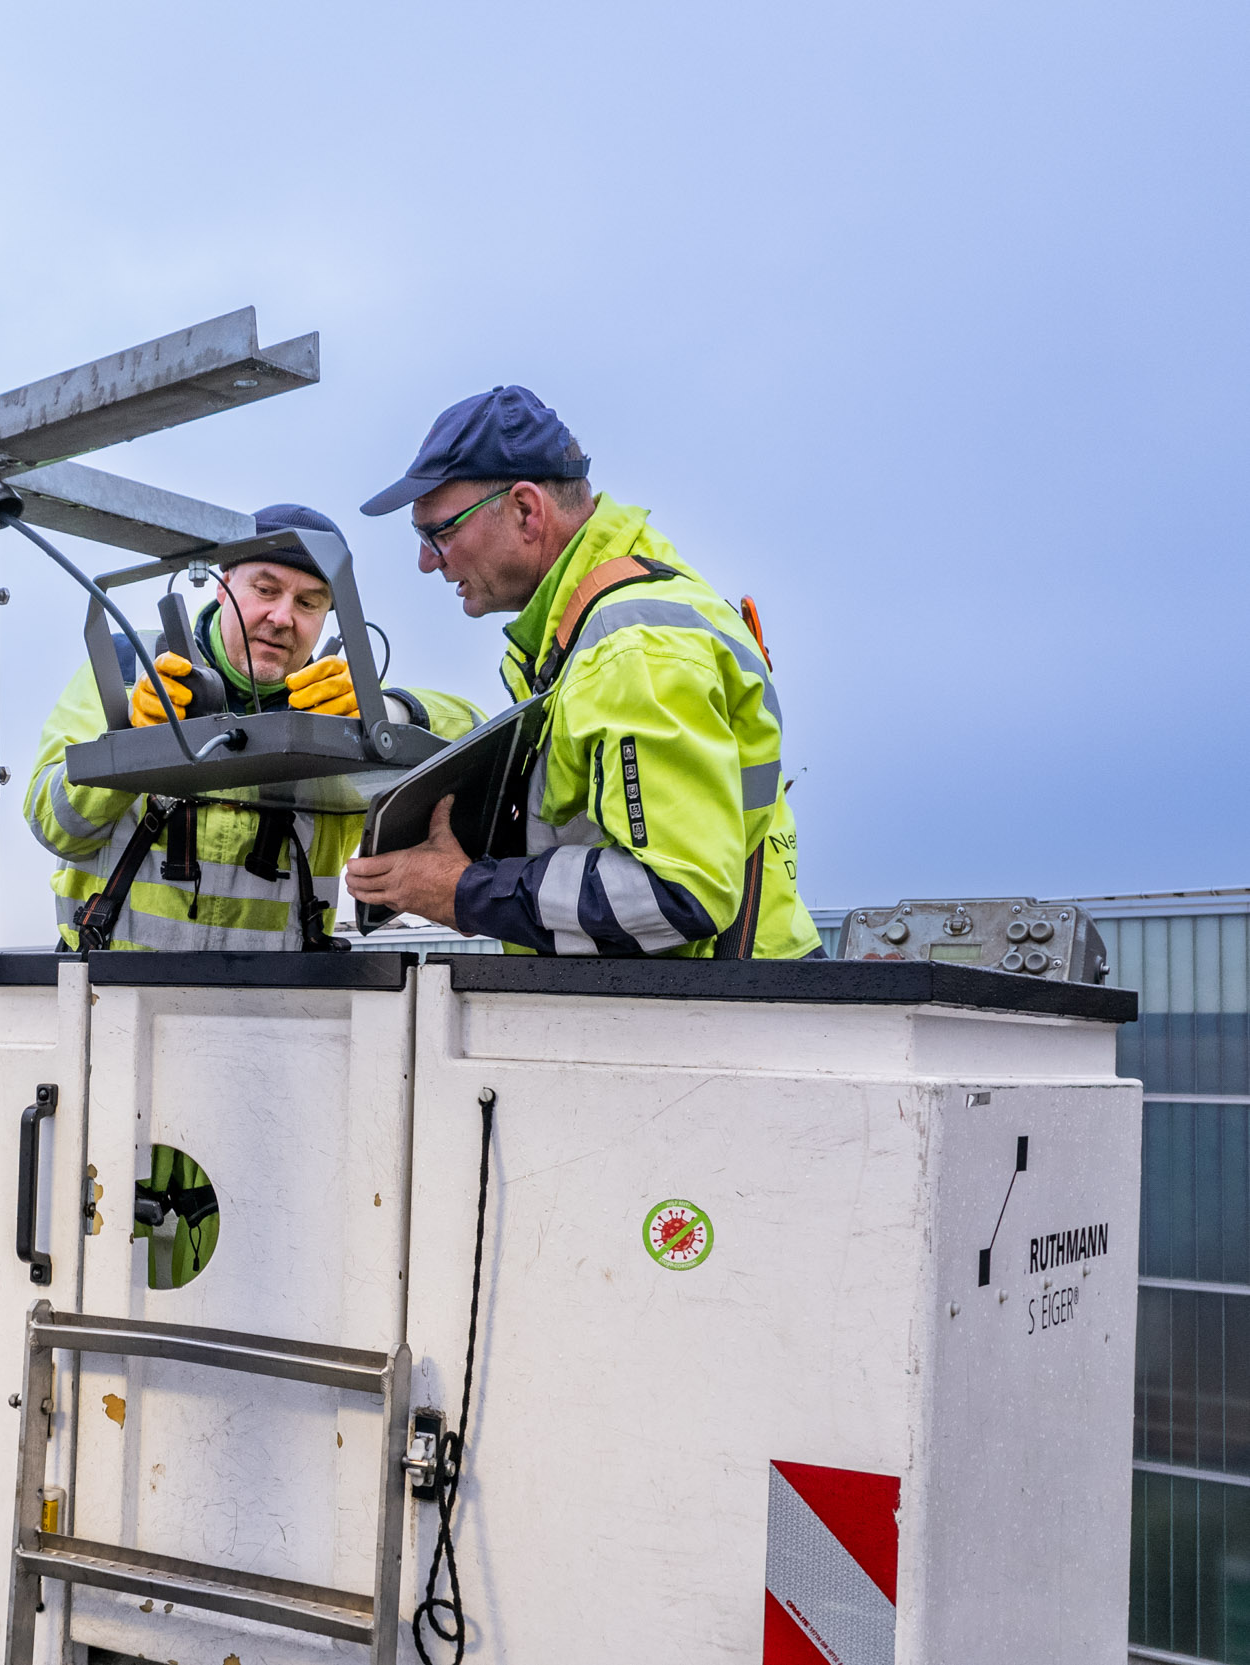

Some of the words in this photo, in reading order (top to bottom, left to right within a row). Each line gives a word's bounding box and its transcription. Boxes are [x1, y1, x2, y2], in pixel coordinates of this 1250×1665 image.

[769, 832, 797, 854] Ne
[784, 860, 797, 880] D
[1030, 1223, 1109, 1274] RUTHMANN
[786, 1599, 811, 1627] ORALITE
